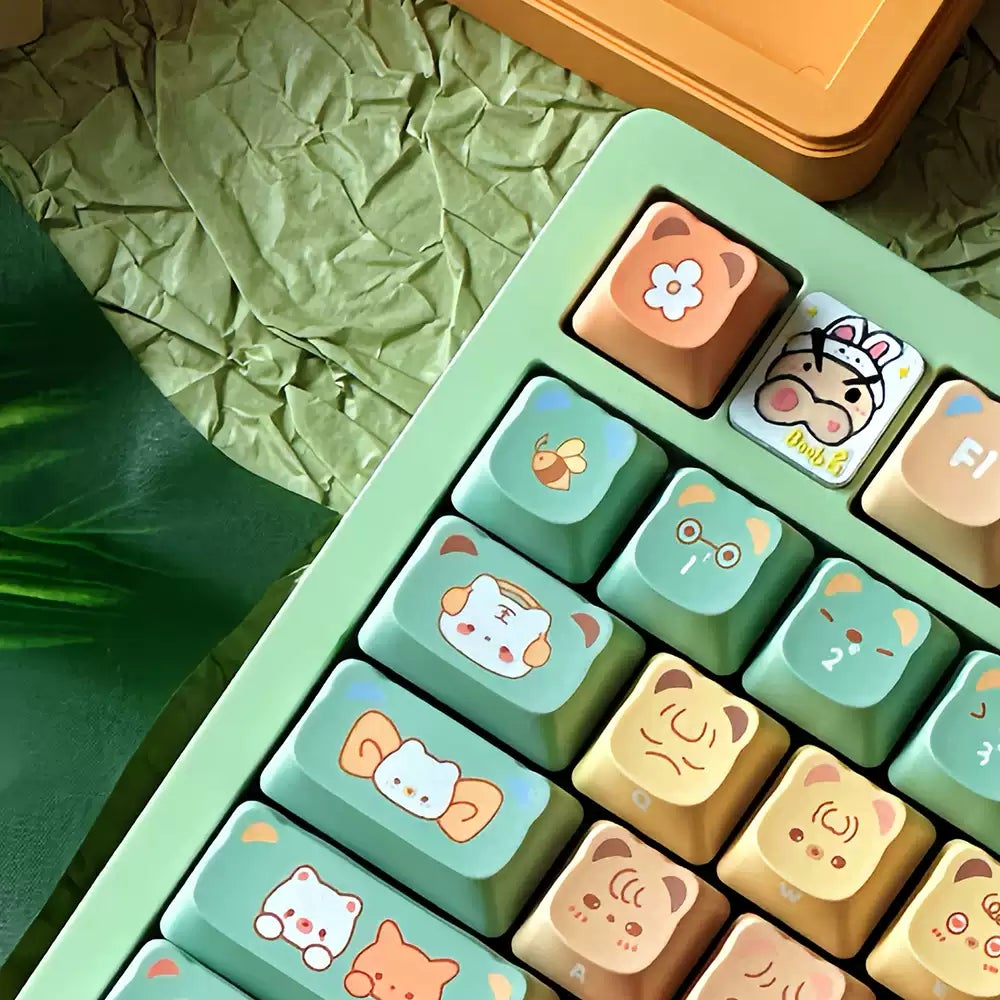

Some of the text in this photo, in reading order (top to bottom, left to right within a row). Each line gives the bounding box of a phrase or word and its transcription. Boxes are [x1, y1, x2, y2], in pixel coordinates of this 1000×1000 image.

[949, 436, 999, 480] F1
[821, 647, 843, 672] 2
[976, 741, 993, 766] 3
[569, 963, 586, 984] A
